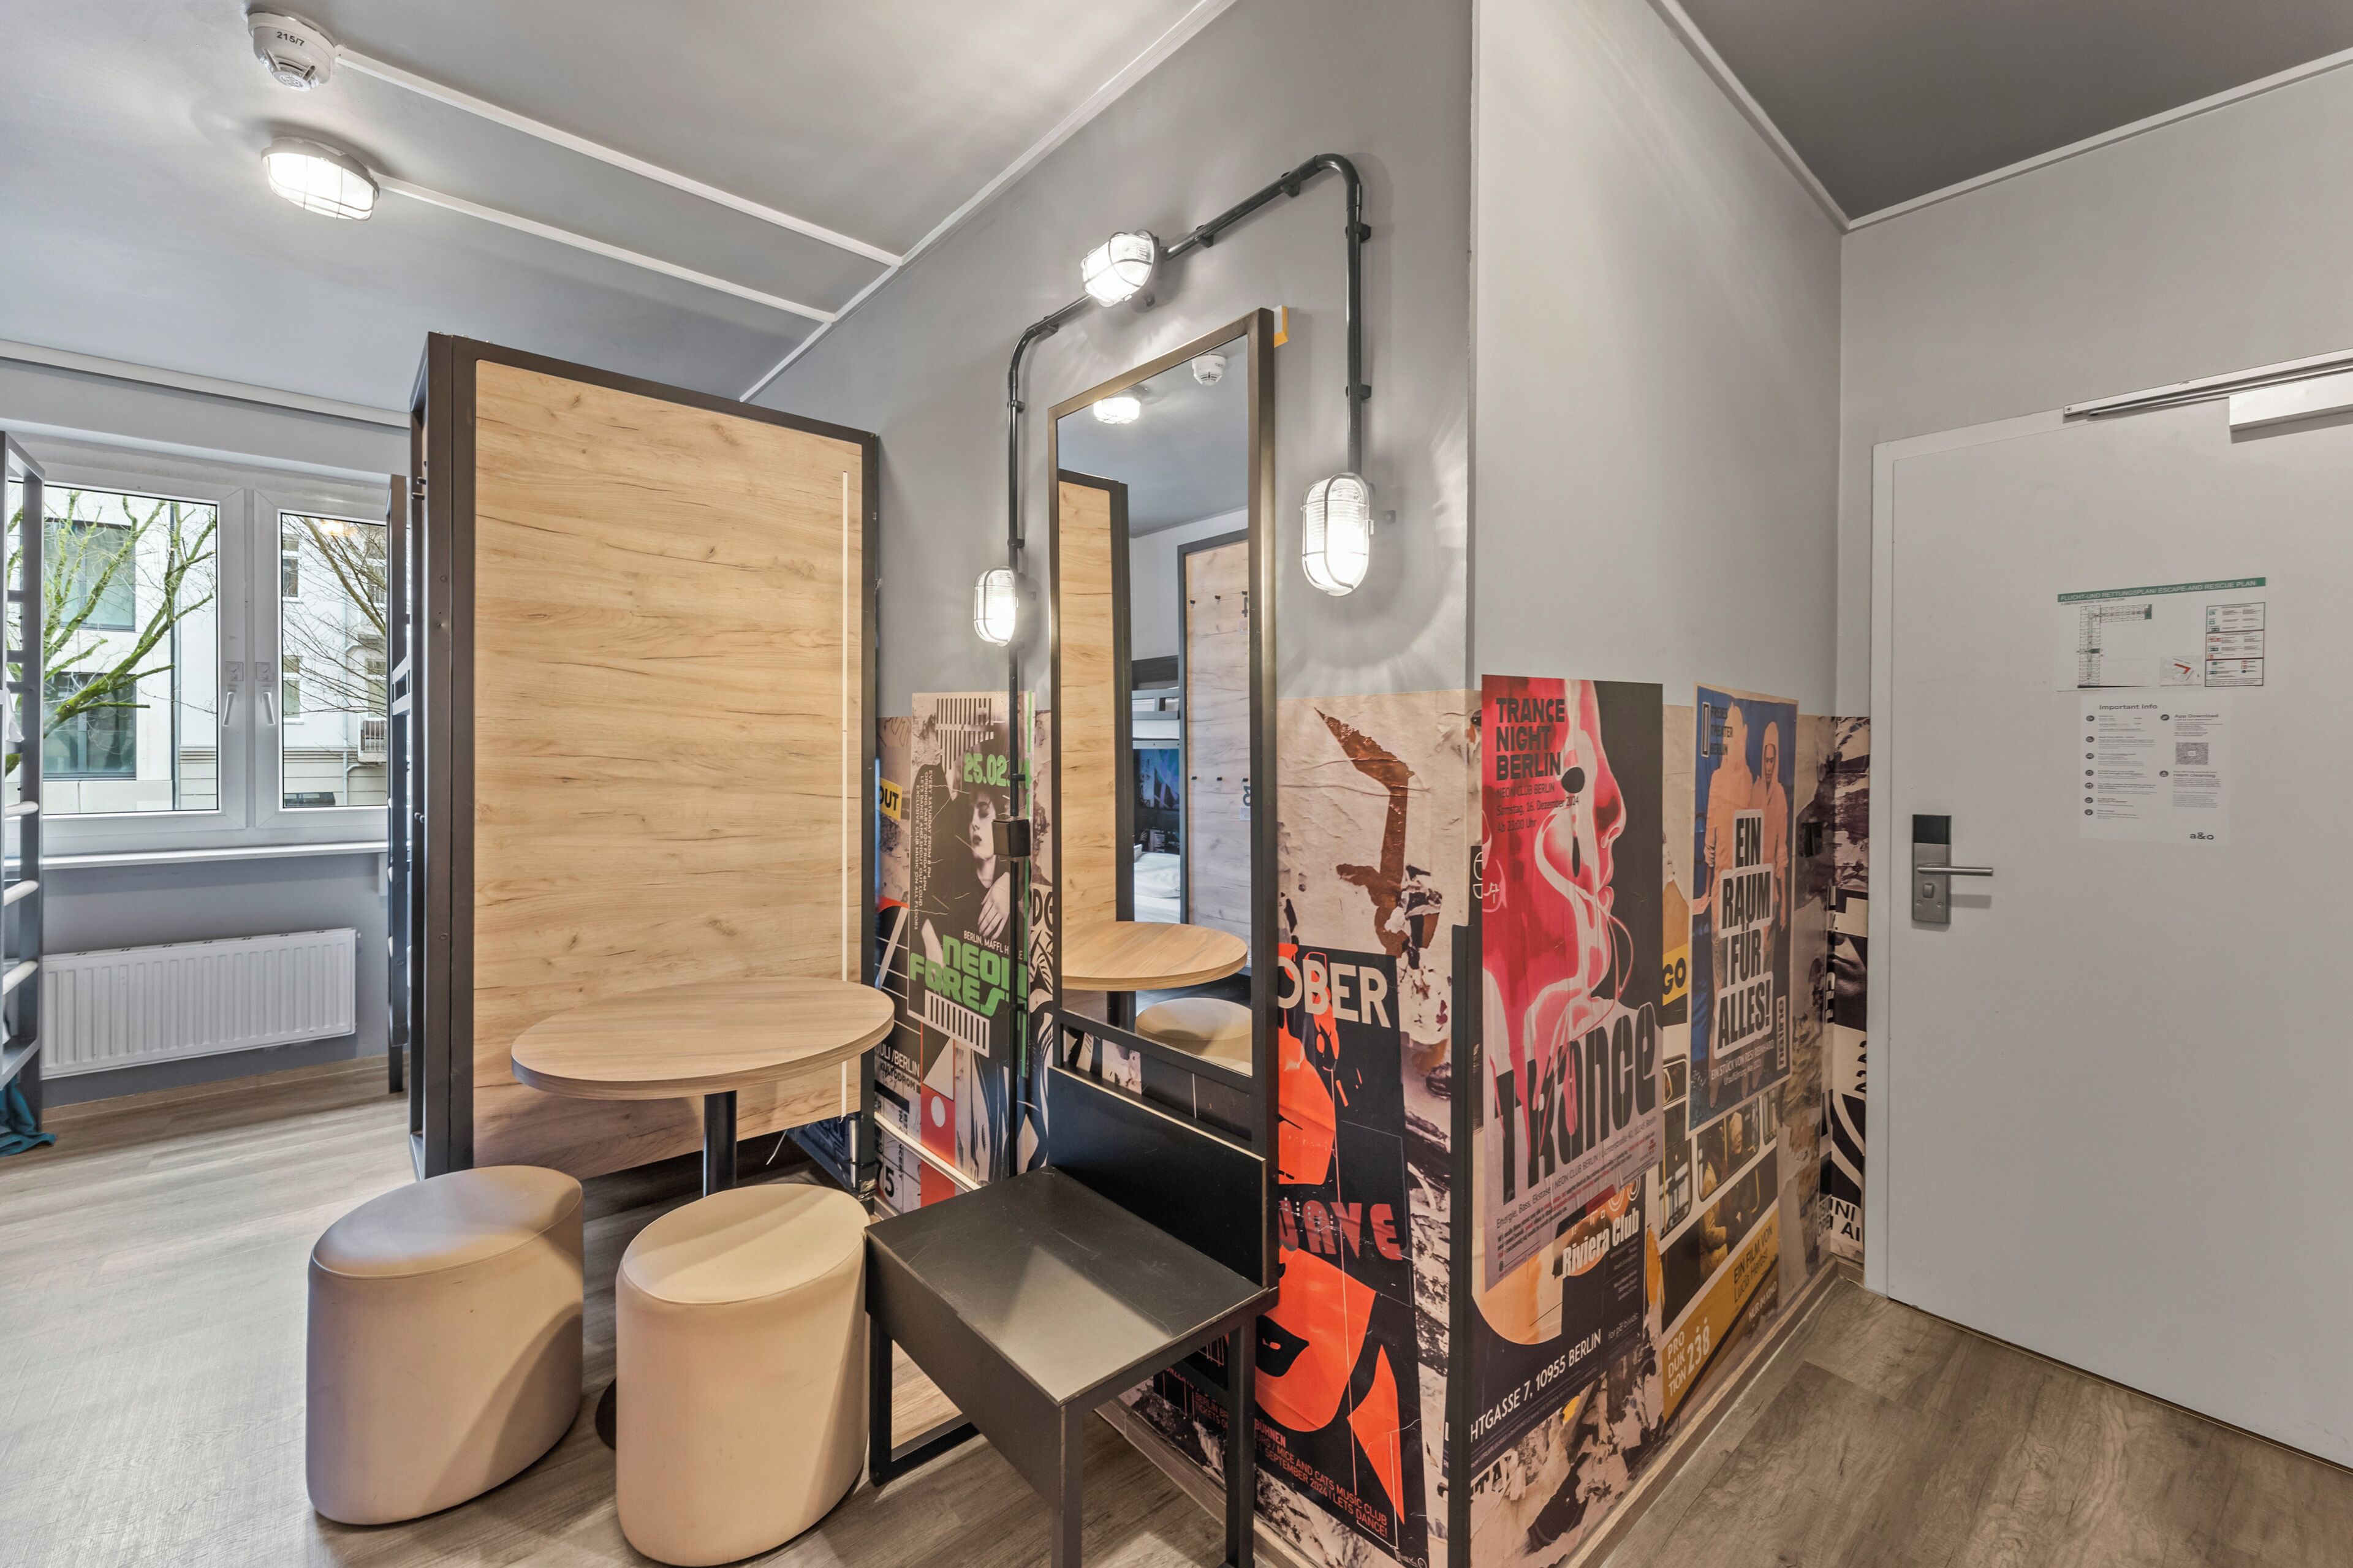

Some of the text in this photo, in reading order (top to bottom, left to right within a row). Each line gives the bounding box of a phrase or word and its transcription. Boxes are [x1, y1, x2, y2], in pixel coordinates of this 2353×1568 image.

[277, 31, 305, 47] 215/7
[1496, 697, 1565, 723] TRANCE
[1496, 726, 1551, 752] NIGHT
[1496, 752, 1561, 781] BERLIN
[1518, 784, 1533, 796] CLUB
[1534, 782, 1555, 794] BERLIN
[1537, 798, 1564, 811] Dezember
[1735, 817, 1762, 868] EIN
[2189, 831, 2214, 840] a&o
[914, 871, 919, 884] ON
[1722, 871, 1771, 930] RAUM
[1730, 923, 1762, 985] FÜR
[1278, 956, 1392, 1028] OBER
[1717, 979, 1770, 1050] ALLES!
[1719, 1061, 1735, 1078] STÜCK
[1554, 1173, 1569, 1187] NEON
[1569, 1165, 1582, 1179] CLUB
[1583, 1154, 1599, 1170] BERLIN
[1563, 1228, 1610, 1279] Riviera
[1612, 1206, 1639, 1247] Club
[1733, 1259, 1745, 1285] EIN
[1746, 1238, 1760, 1269] FILM
[1748, 1301, 1760, 1322] NUR
[1668, 1331, 1684, 1360] PRO
[1669, 1348, 1685, 1379] DUK
[1471, 1387, 1521, 1444] HTGASSE
[1536, 1355, 1566, 1392] 10955
[1569, 1328, 1601, 1368] BERLIN
[1669, 1365, 1686, 1397] TION
[1265, 1448, 1388, 1539] SEPTEMBER 2024 LETS DANCE!
[1276, 1447, 1294, 1464] MICE
[1296, 1458, 1313, 1476] AND
[1314, 1471, 1335, 1491] CATS
[1336, 1483, 1362, 1509] MUSIC
[1363, 1504, 1387, 1526] CLUB
